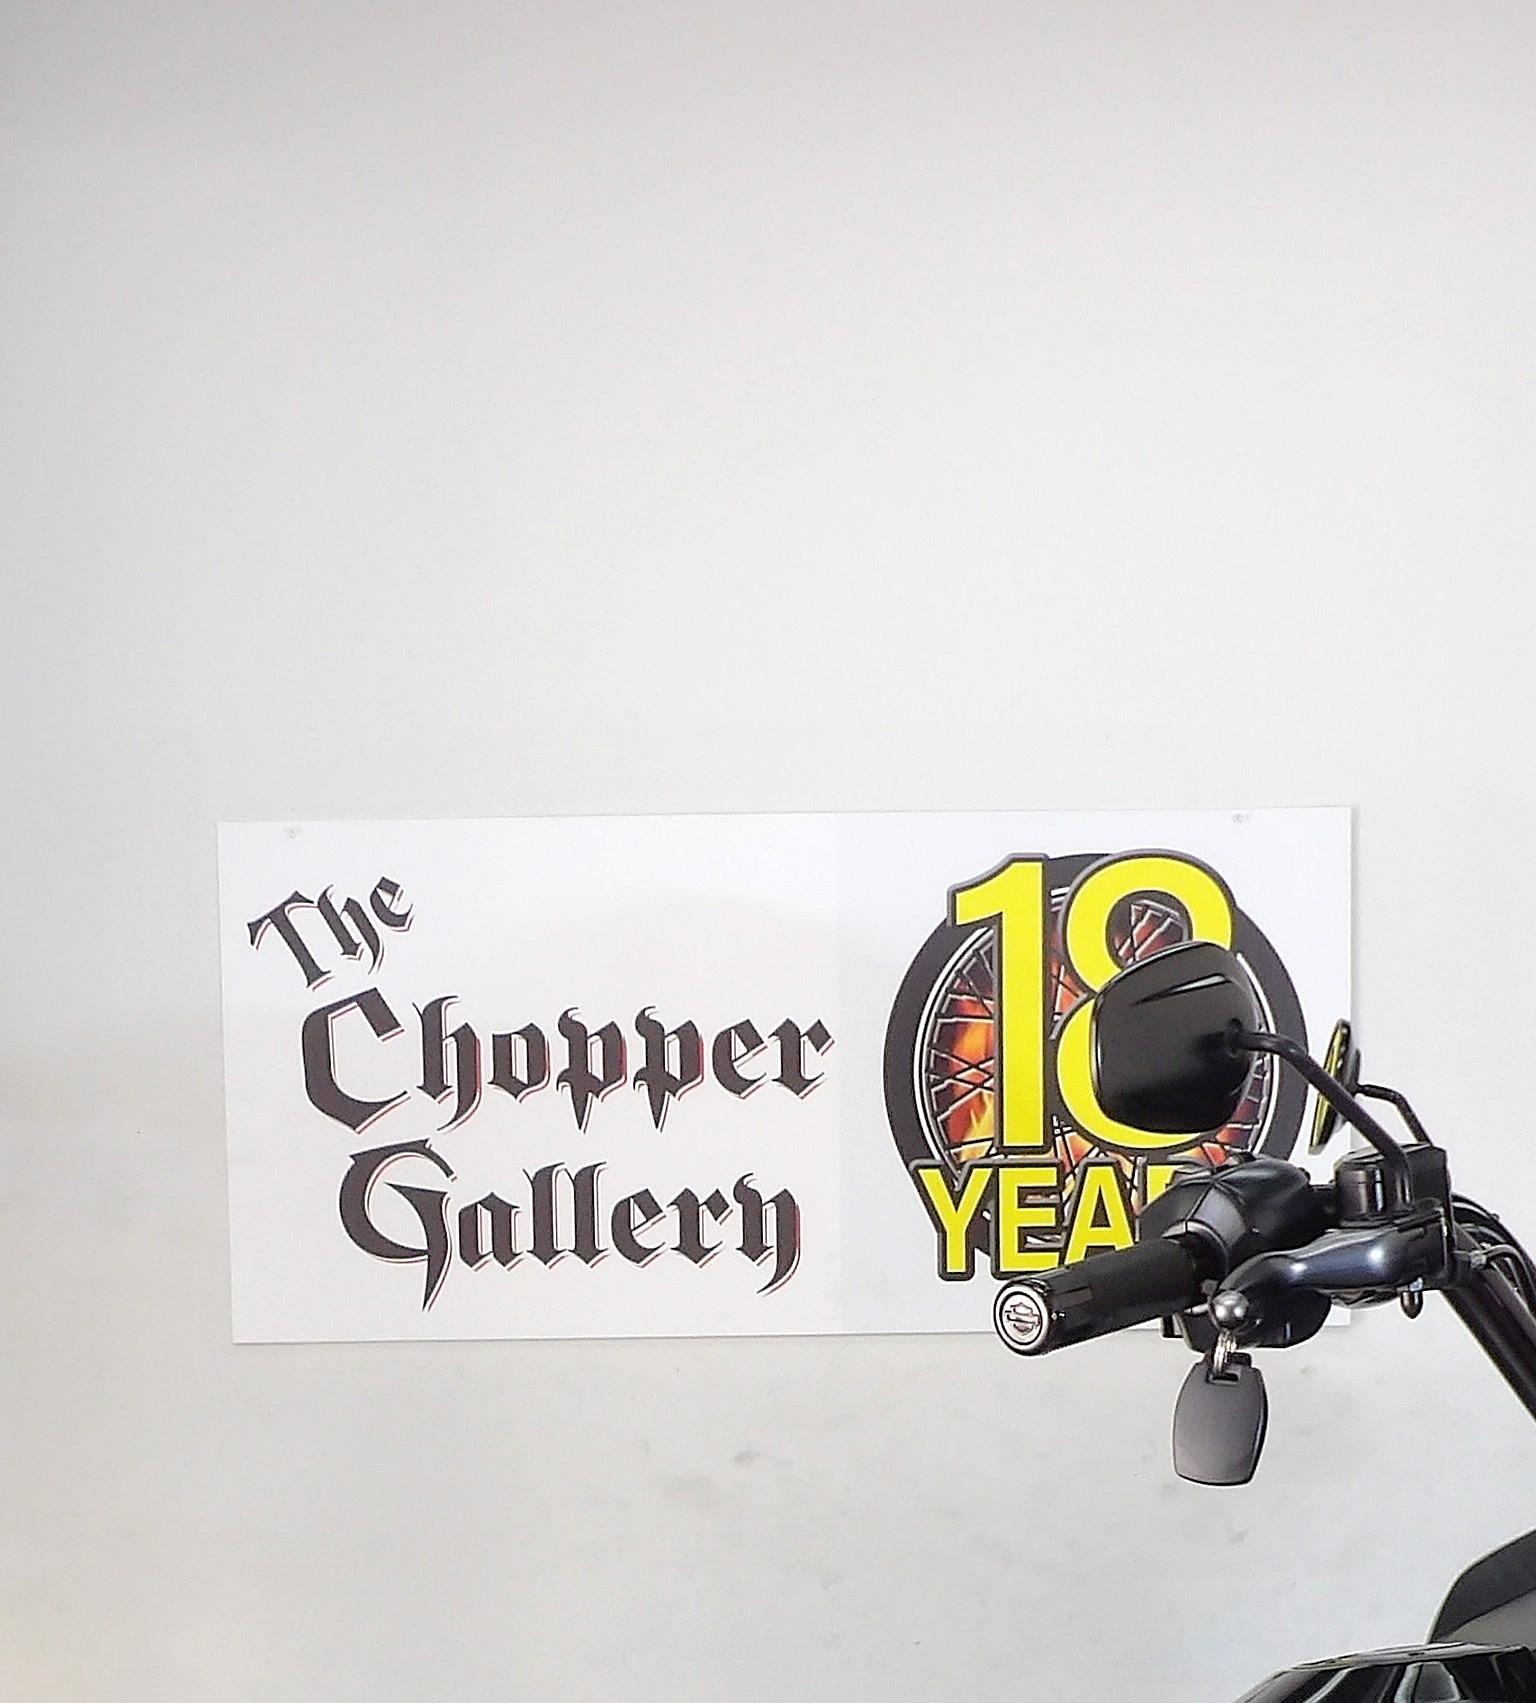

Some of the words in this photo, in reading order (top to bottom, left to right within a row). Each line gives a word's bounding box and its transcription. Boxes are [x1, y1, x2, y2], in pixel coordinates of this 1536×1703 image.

[247, 875, 414, 991] The
[954, 855, 1234, 1151] 18
[302, 987, 835, 1135] Chopper
[338, 1138, 802, 1312] Gallery
[918, 1164, 1182, 1274] YEA
